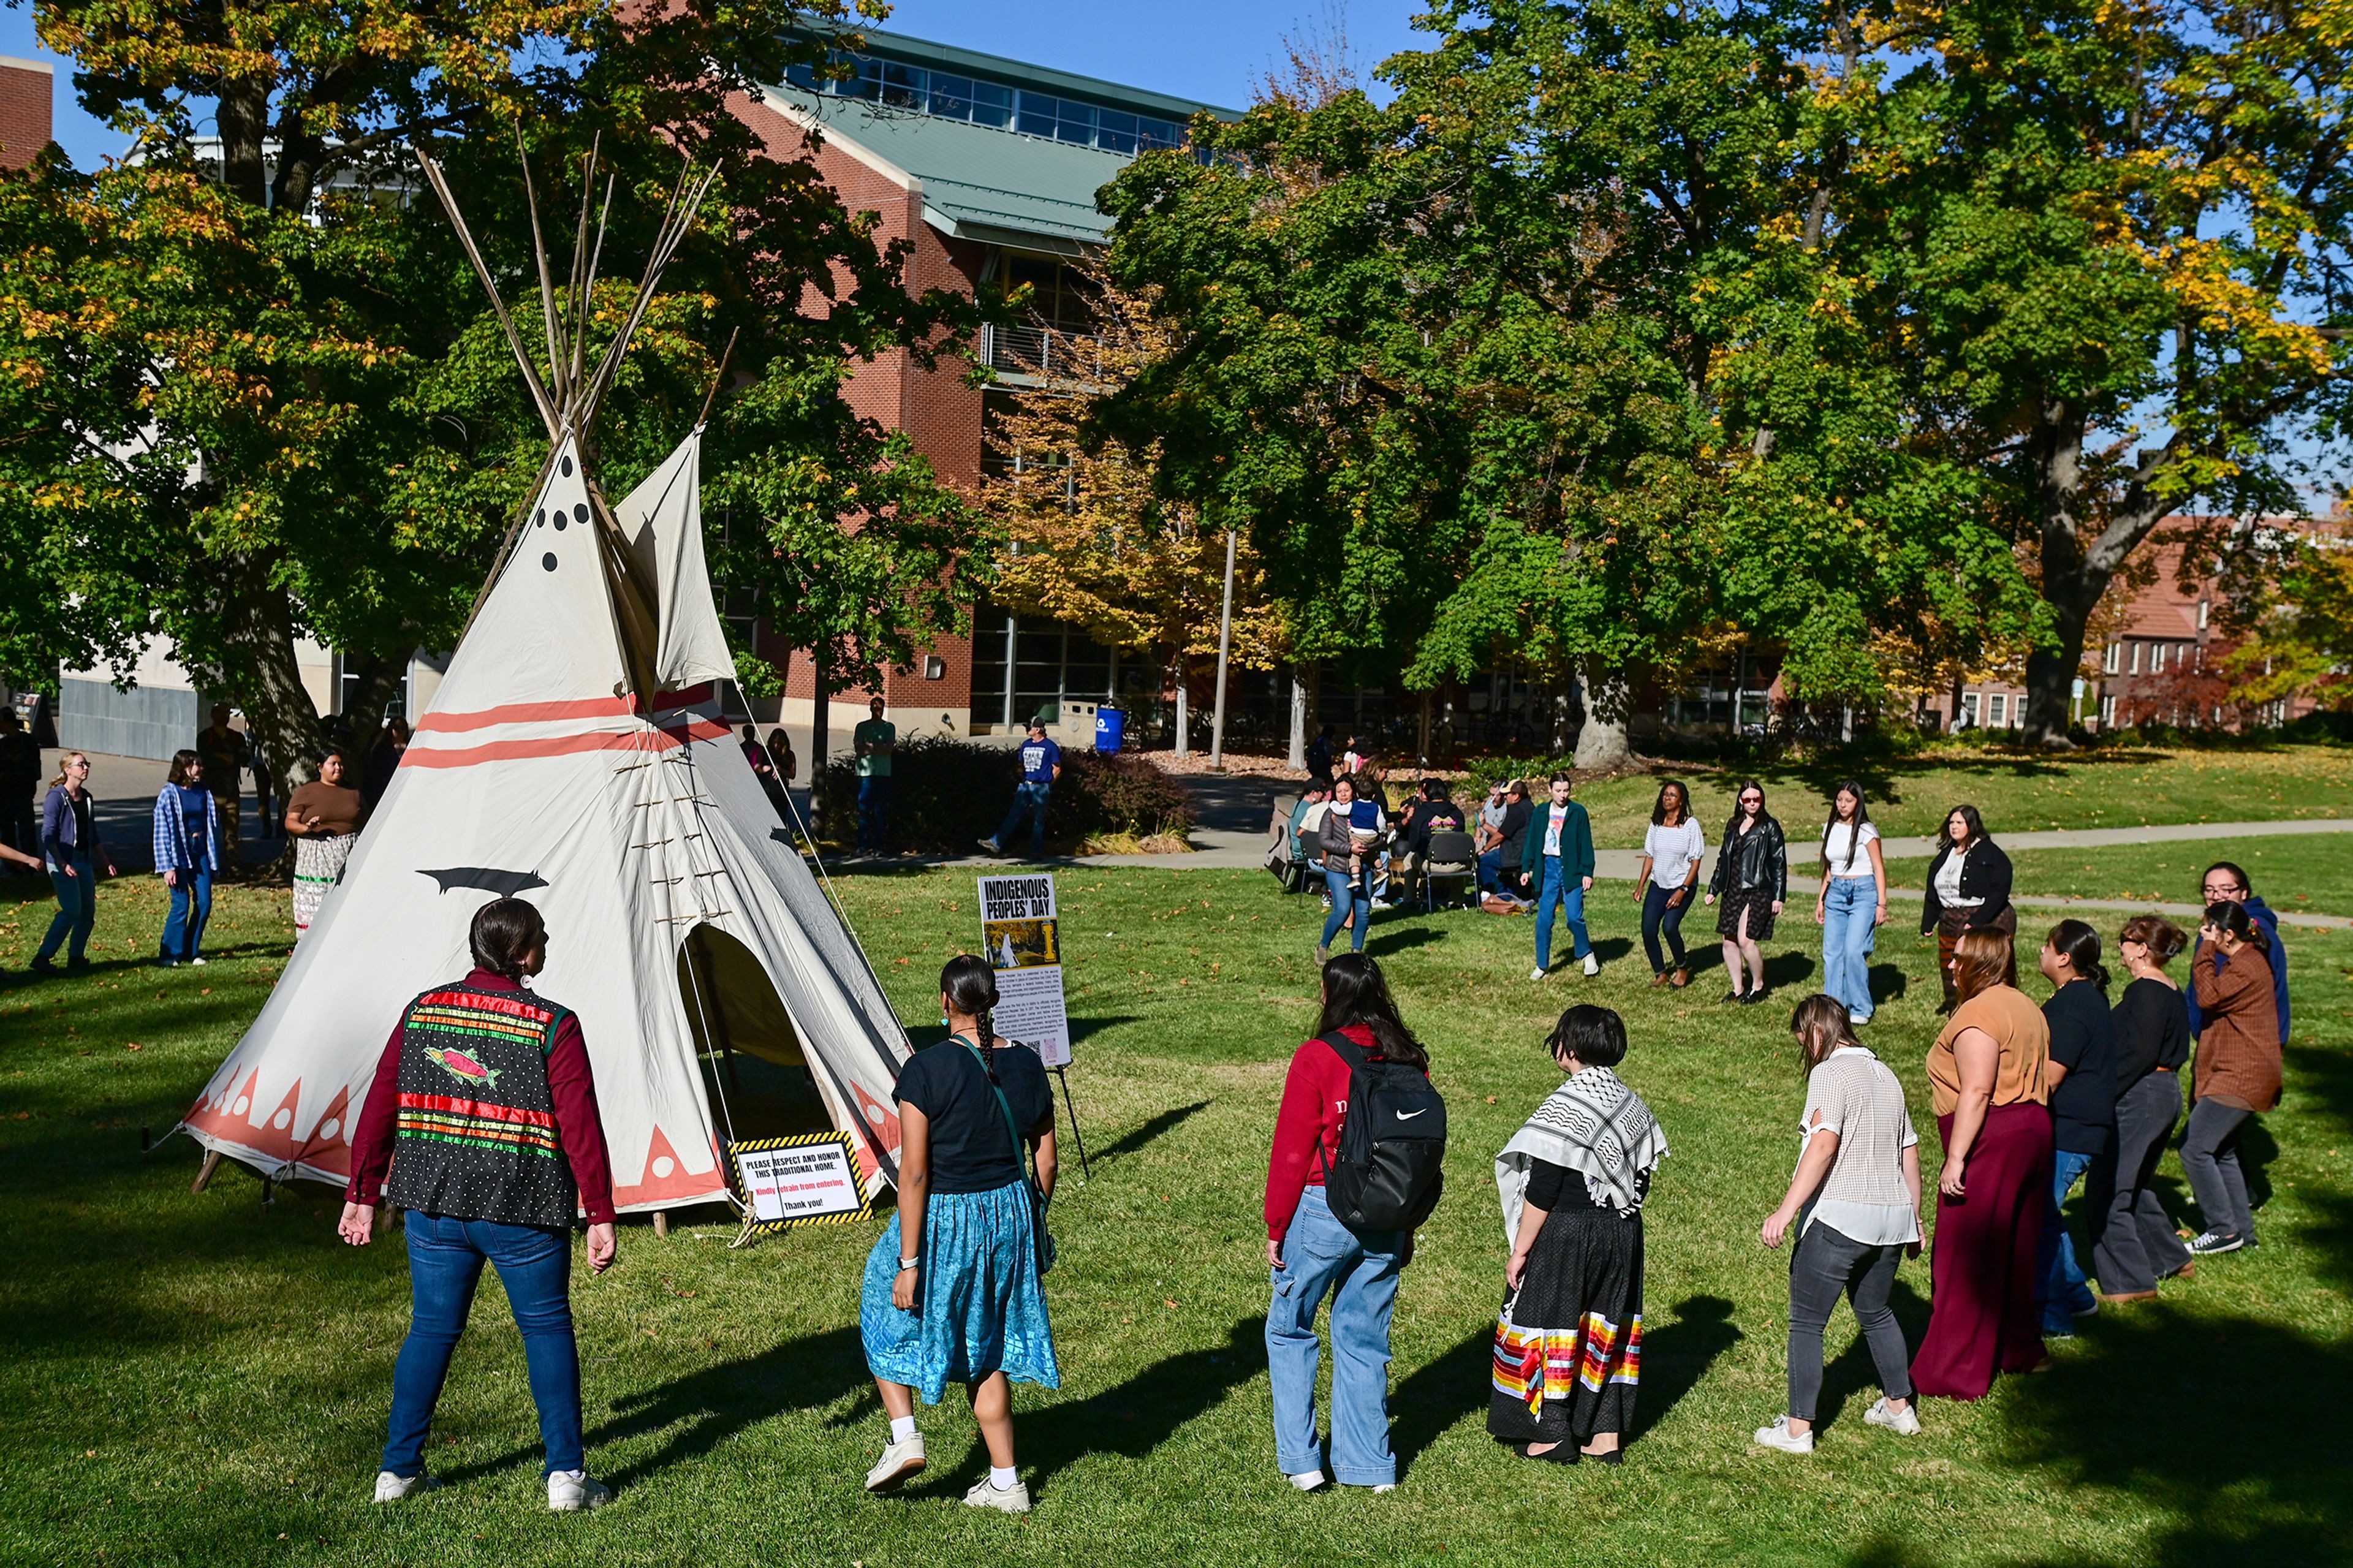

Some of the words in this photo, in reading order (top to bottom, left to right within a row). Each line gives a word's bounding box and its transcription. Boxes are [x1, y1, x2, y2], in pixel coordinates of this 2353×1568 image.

[985, 878, 1049, 901] INDIGENOUS
[987, 900, 1028, 919] PEOPLES'
[1031, 898, 1049, 917] DAY
[746, 1159, 771, 1170] PLEASE
[773, 1156, 801, 1167] RESPECT
[803, 1154, 816, 1163] AND
[817, 1151, 841, 1161] HONOR
[755, 1169, 770, 1178] THIS
[772, 1164, 814, 1176] TRADITIONAL
[814, 1162, 837, 1172] HOME.
[756, 1186, 776, 1196] Kindly
[800, 1182, 815, 1191] from
[816, 1179, 845, 1189] entering.
[784, 1200, 806, 1210] Thank
[808, 1199, 824, 1208] you!
